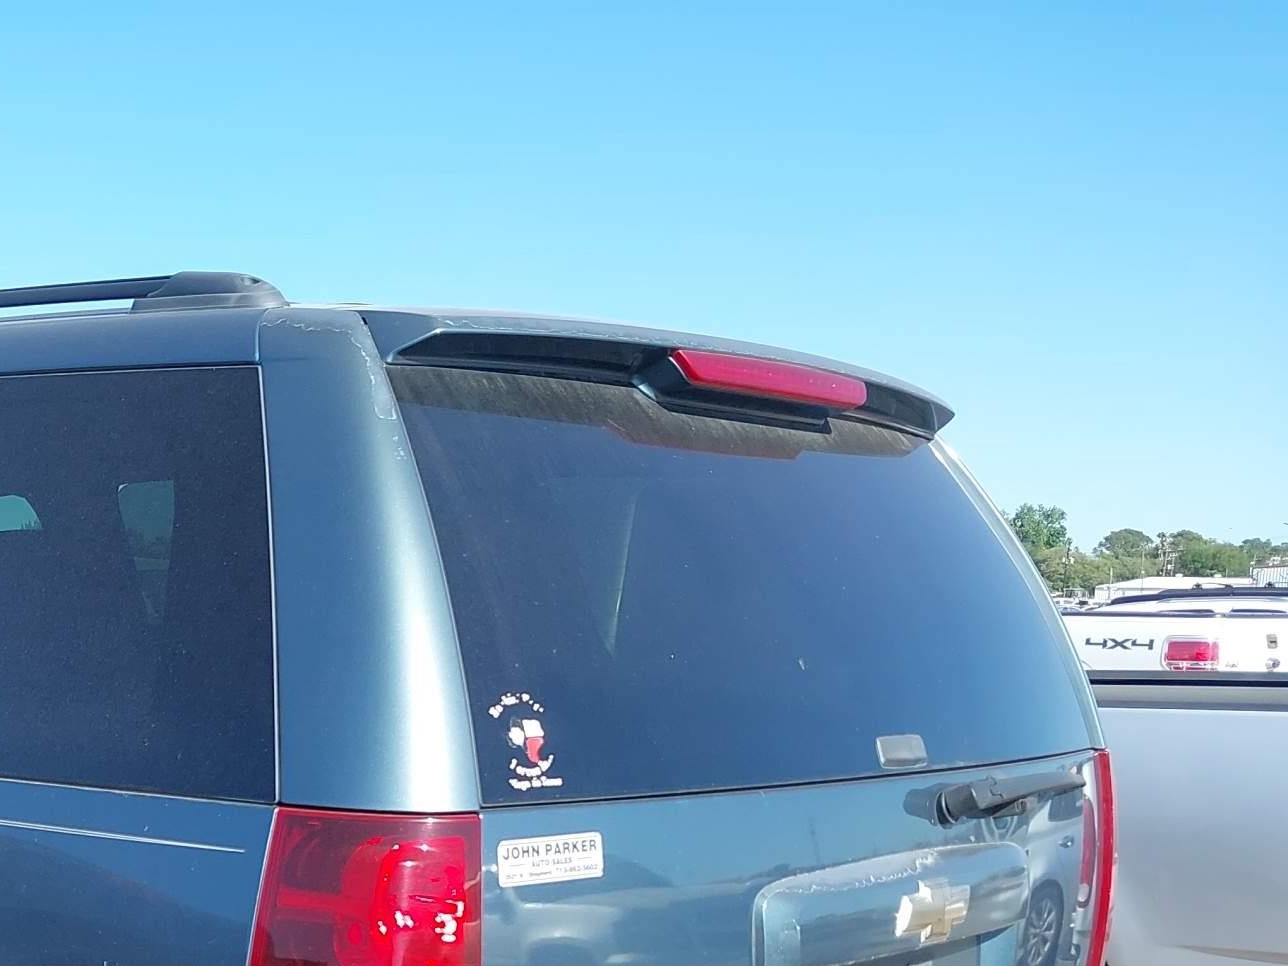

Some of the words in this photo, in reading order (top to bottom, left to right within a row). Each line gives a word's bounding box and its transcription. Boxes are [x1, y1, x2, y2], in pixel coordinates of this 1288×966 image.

[503, 845, 540, 860] JOHN
[545, 839, 597, 856] PARKER
[532, 859, 550, 867] AUTO
[552, 857, 573, 866] SALES
